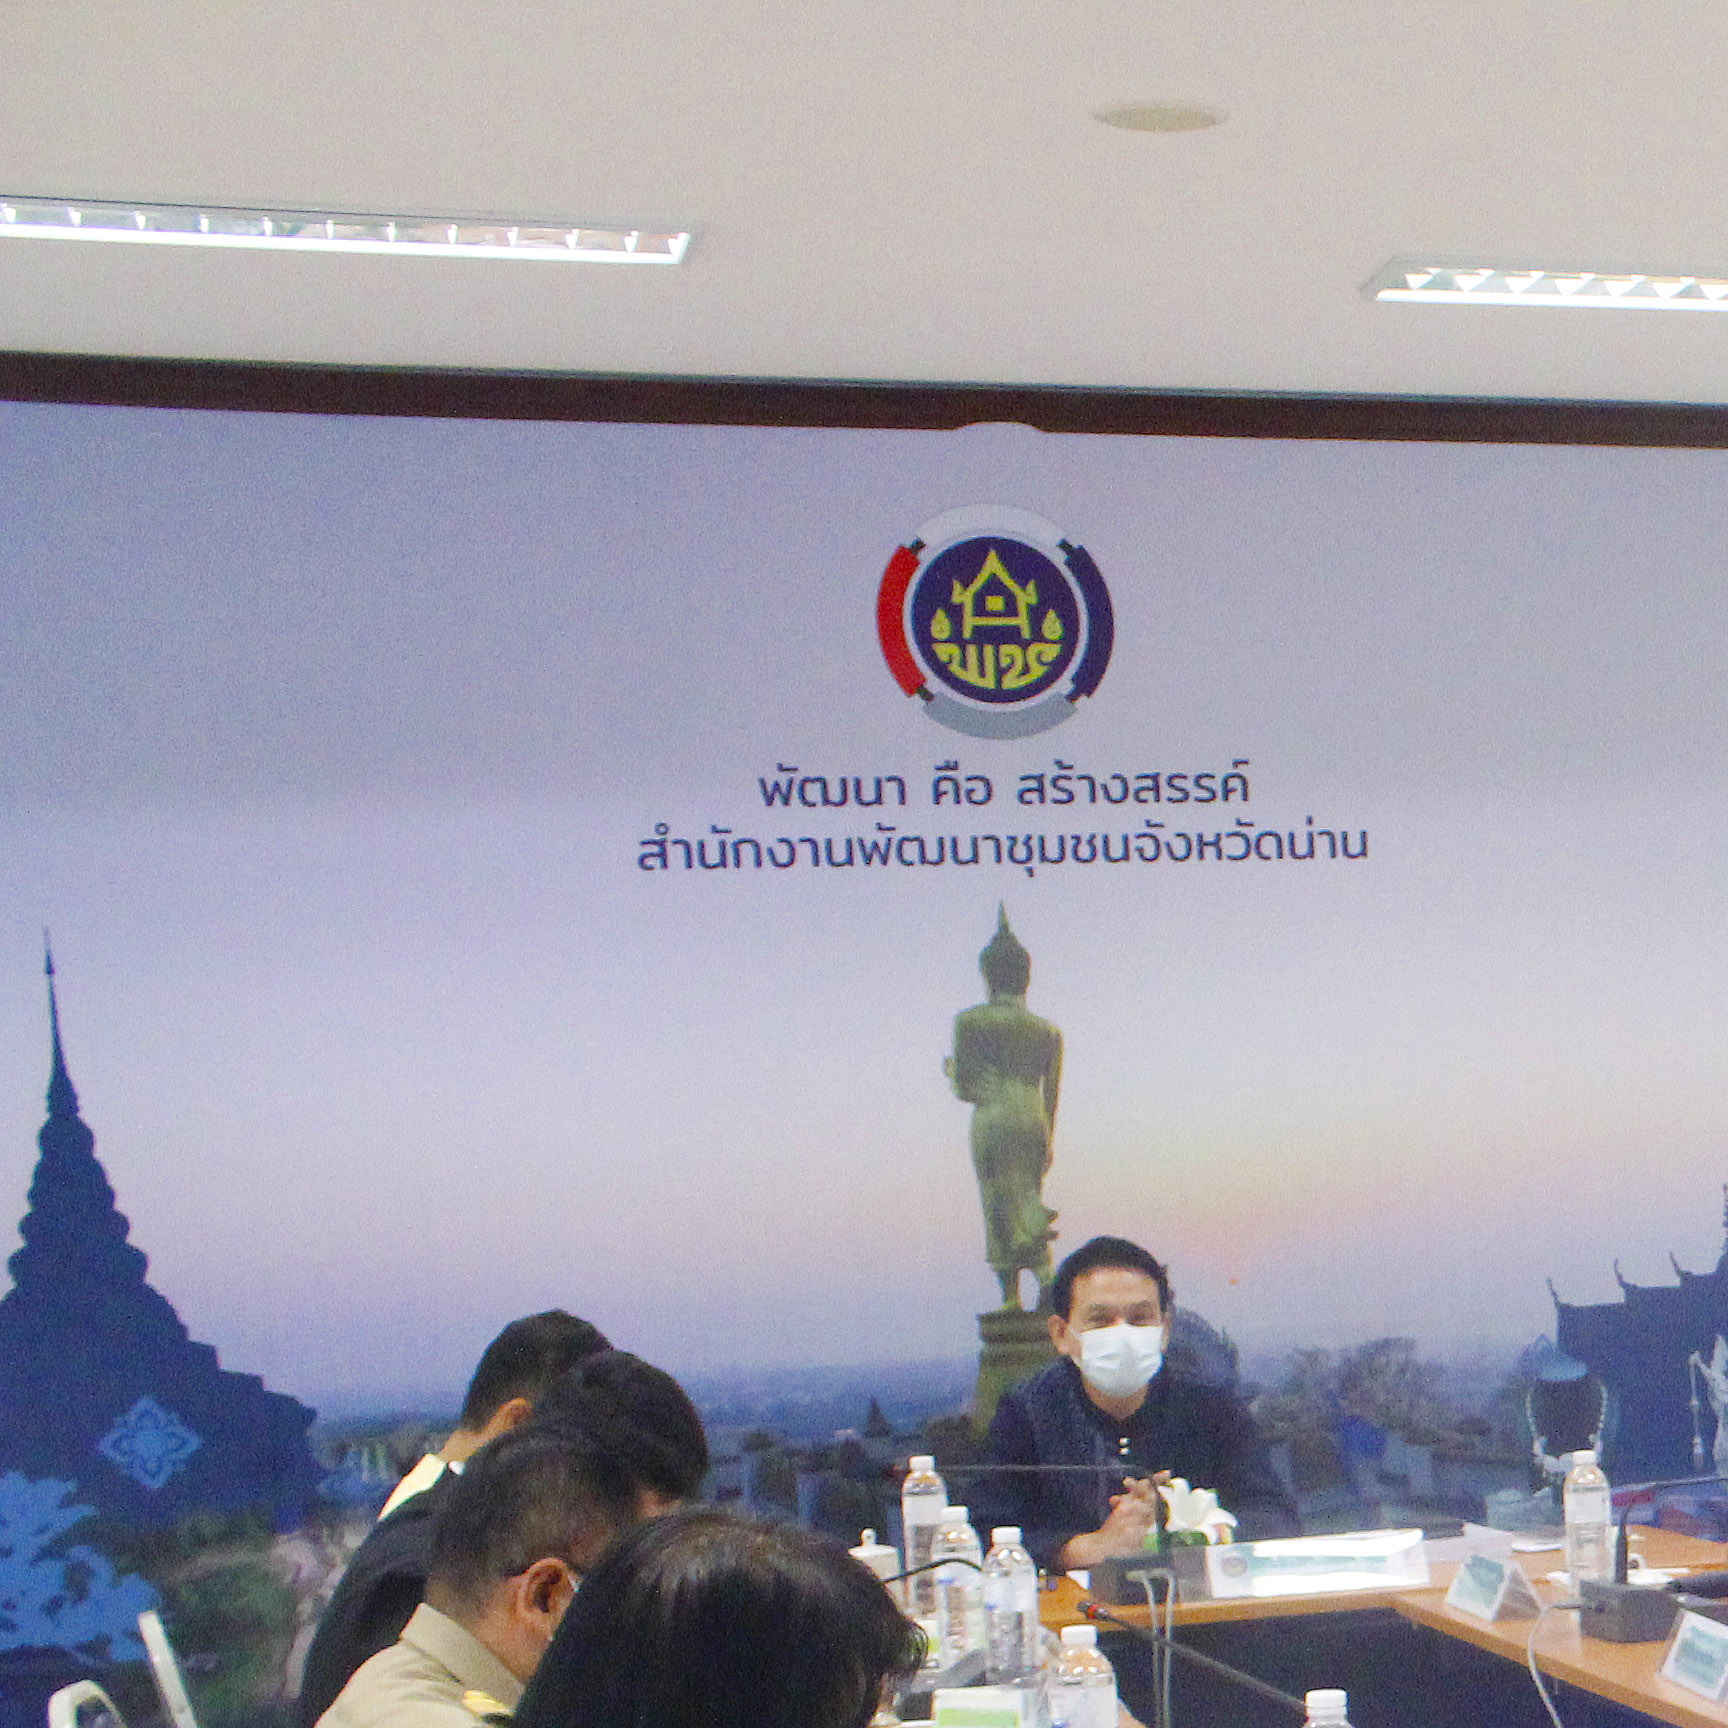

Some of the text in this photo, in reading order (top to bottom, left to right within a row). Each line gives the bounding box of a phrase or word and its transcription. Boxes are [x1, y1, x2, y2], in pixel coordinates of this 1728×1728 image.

[757, 759, 1252, 808] พัฒนา คือ สร้างสรรค์
[636, 816, 1369, 878] สำนักงานพัฒนาชุมชนจังหวัดน่าน
